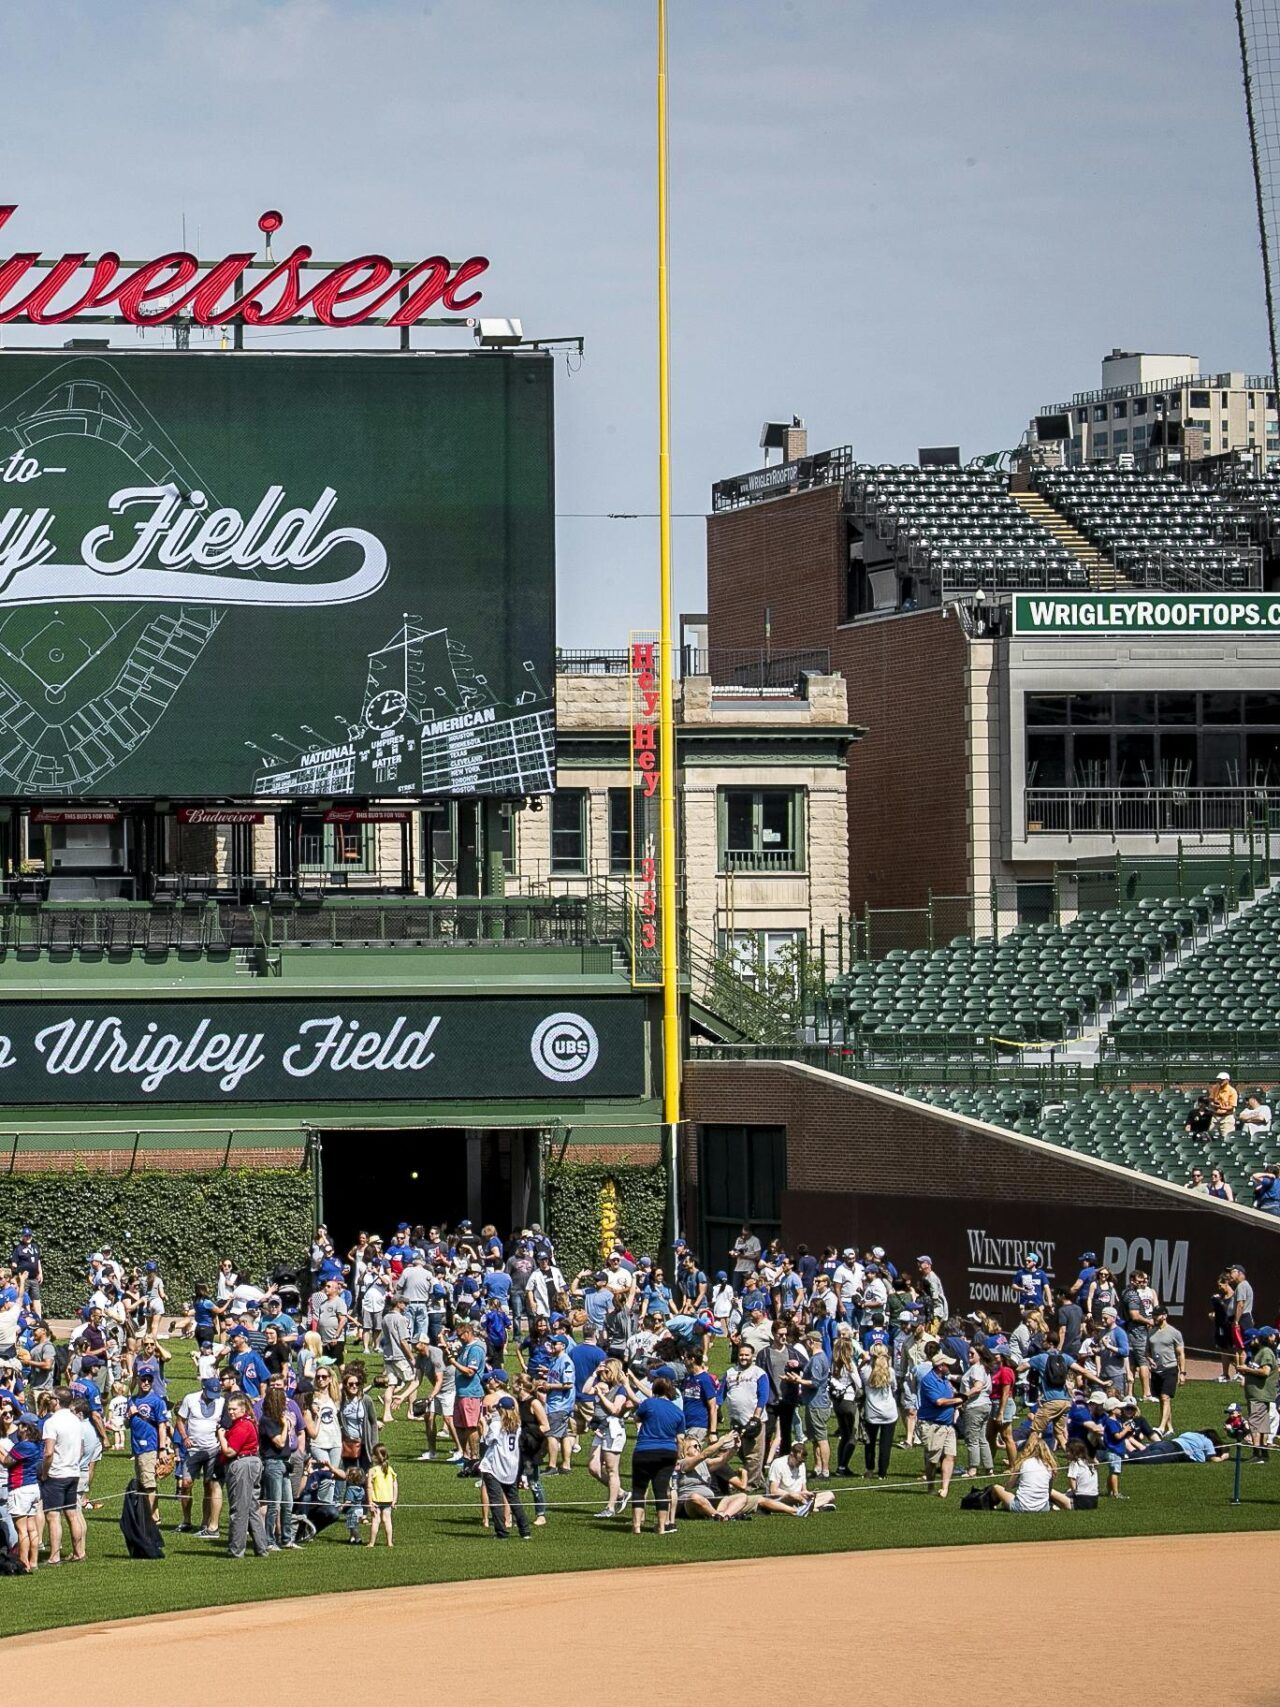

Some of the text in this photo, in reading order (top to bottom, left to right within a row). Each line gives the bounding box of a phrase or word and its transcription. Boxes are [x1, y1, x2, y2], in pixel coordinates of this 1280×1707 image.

[81, 482, 338, 576] Field
[421, 708, 495, 738] AMERICAN
[301, 744, 356, 767] NATIONAL
[372, 754, 402, 769] BATTER
[186, 808, 257, 824] Budweiser
[34, 1015, 266, 1092] Wrigley
[282, 1015, 443, 1078] Field
[967, 1229, 1056, 1271] WINTRUST
[1103, 1235, 1190, 1304] PCM
[969, 1283, 1000, 1302] ZOOM
